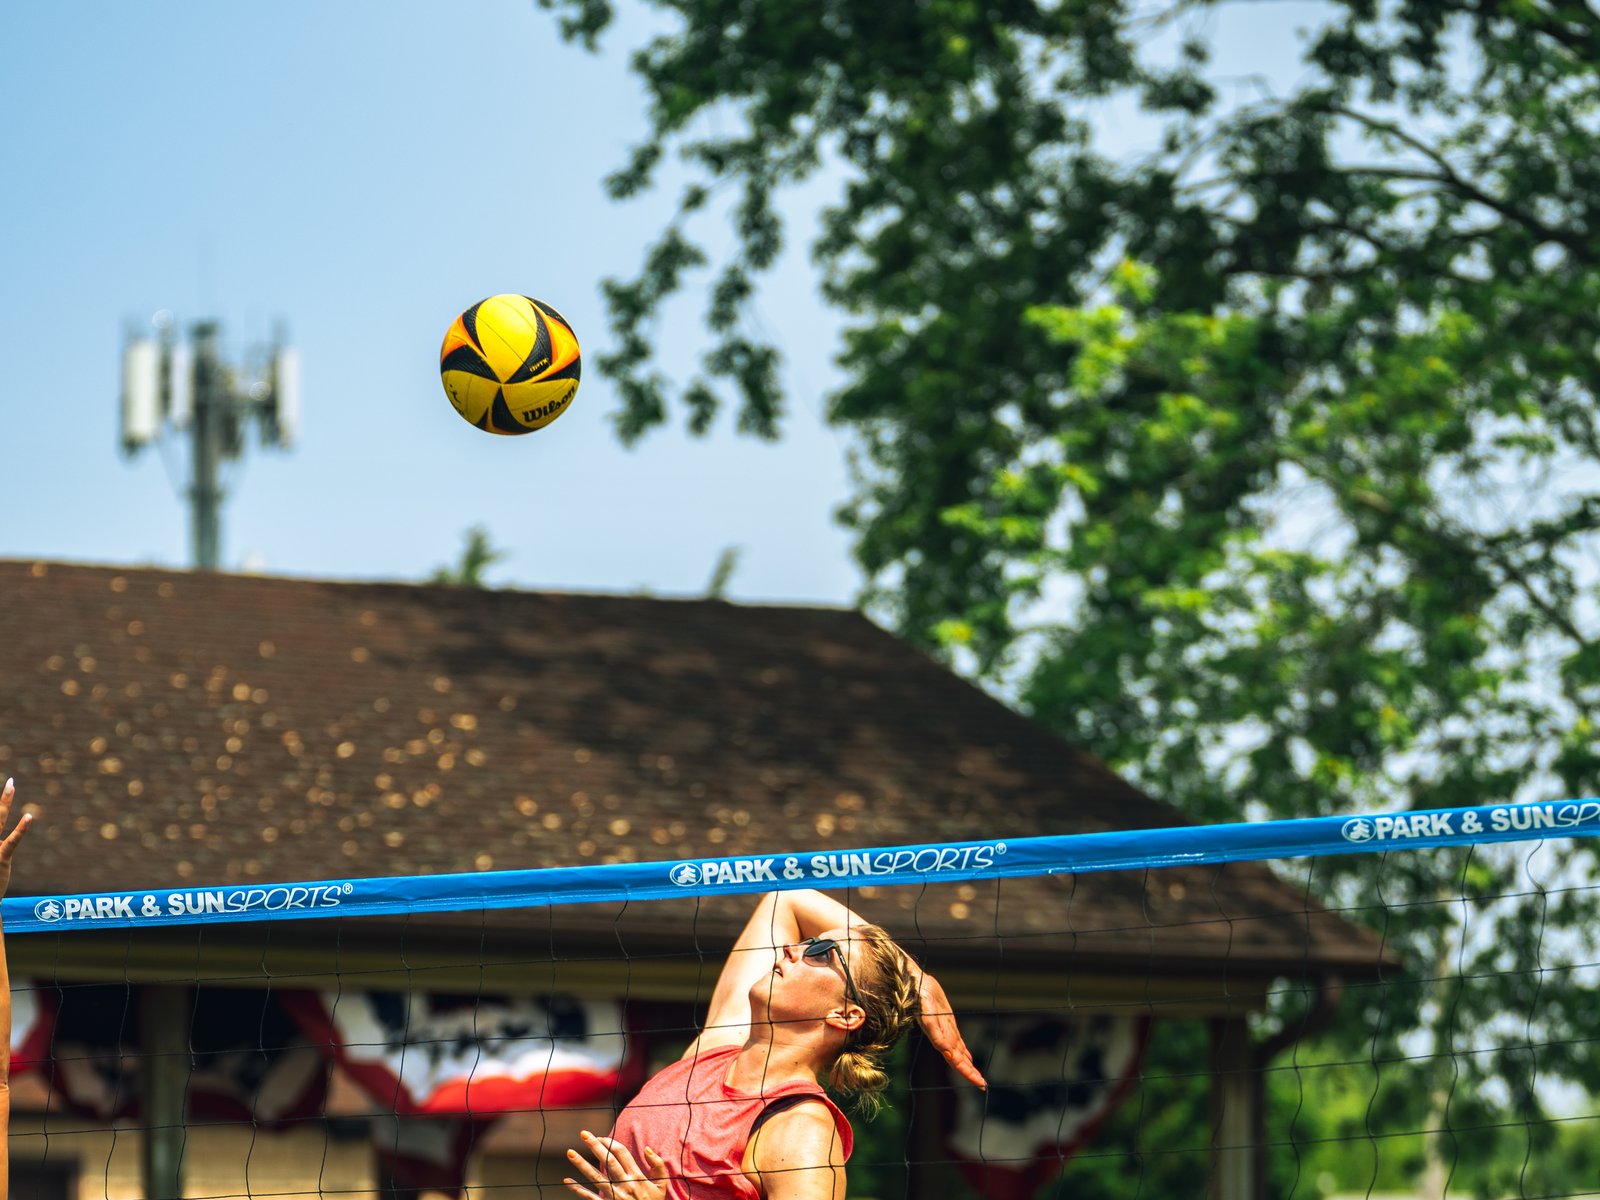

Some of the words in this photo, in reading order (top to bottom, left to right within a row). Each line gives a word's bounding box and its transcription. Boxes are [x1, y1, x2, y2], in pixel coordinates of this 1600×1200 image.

[522, 386, 575, 423] Wilson
[1375, 813, 1455, 840] PARK
[1461, 811, 1484, 834] &
[1490, 802, 1600, 830] SUNSP
[701, 857, 777, 885] PARK
[783, 856, 805, 880] &
[65, 894, 134, 920] PARK
[141, 896, 162, 917] &
